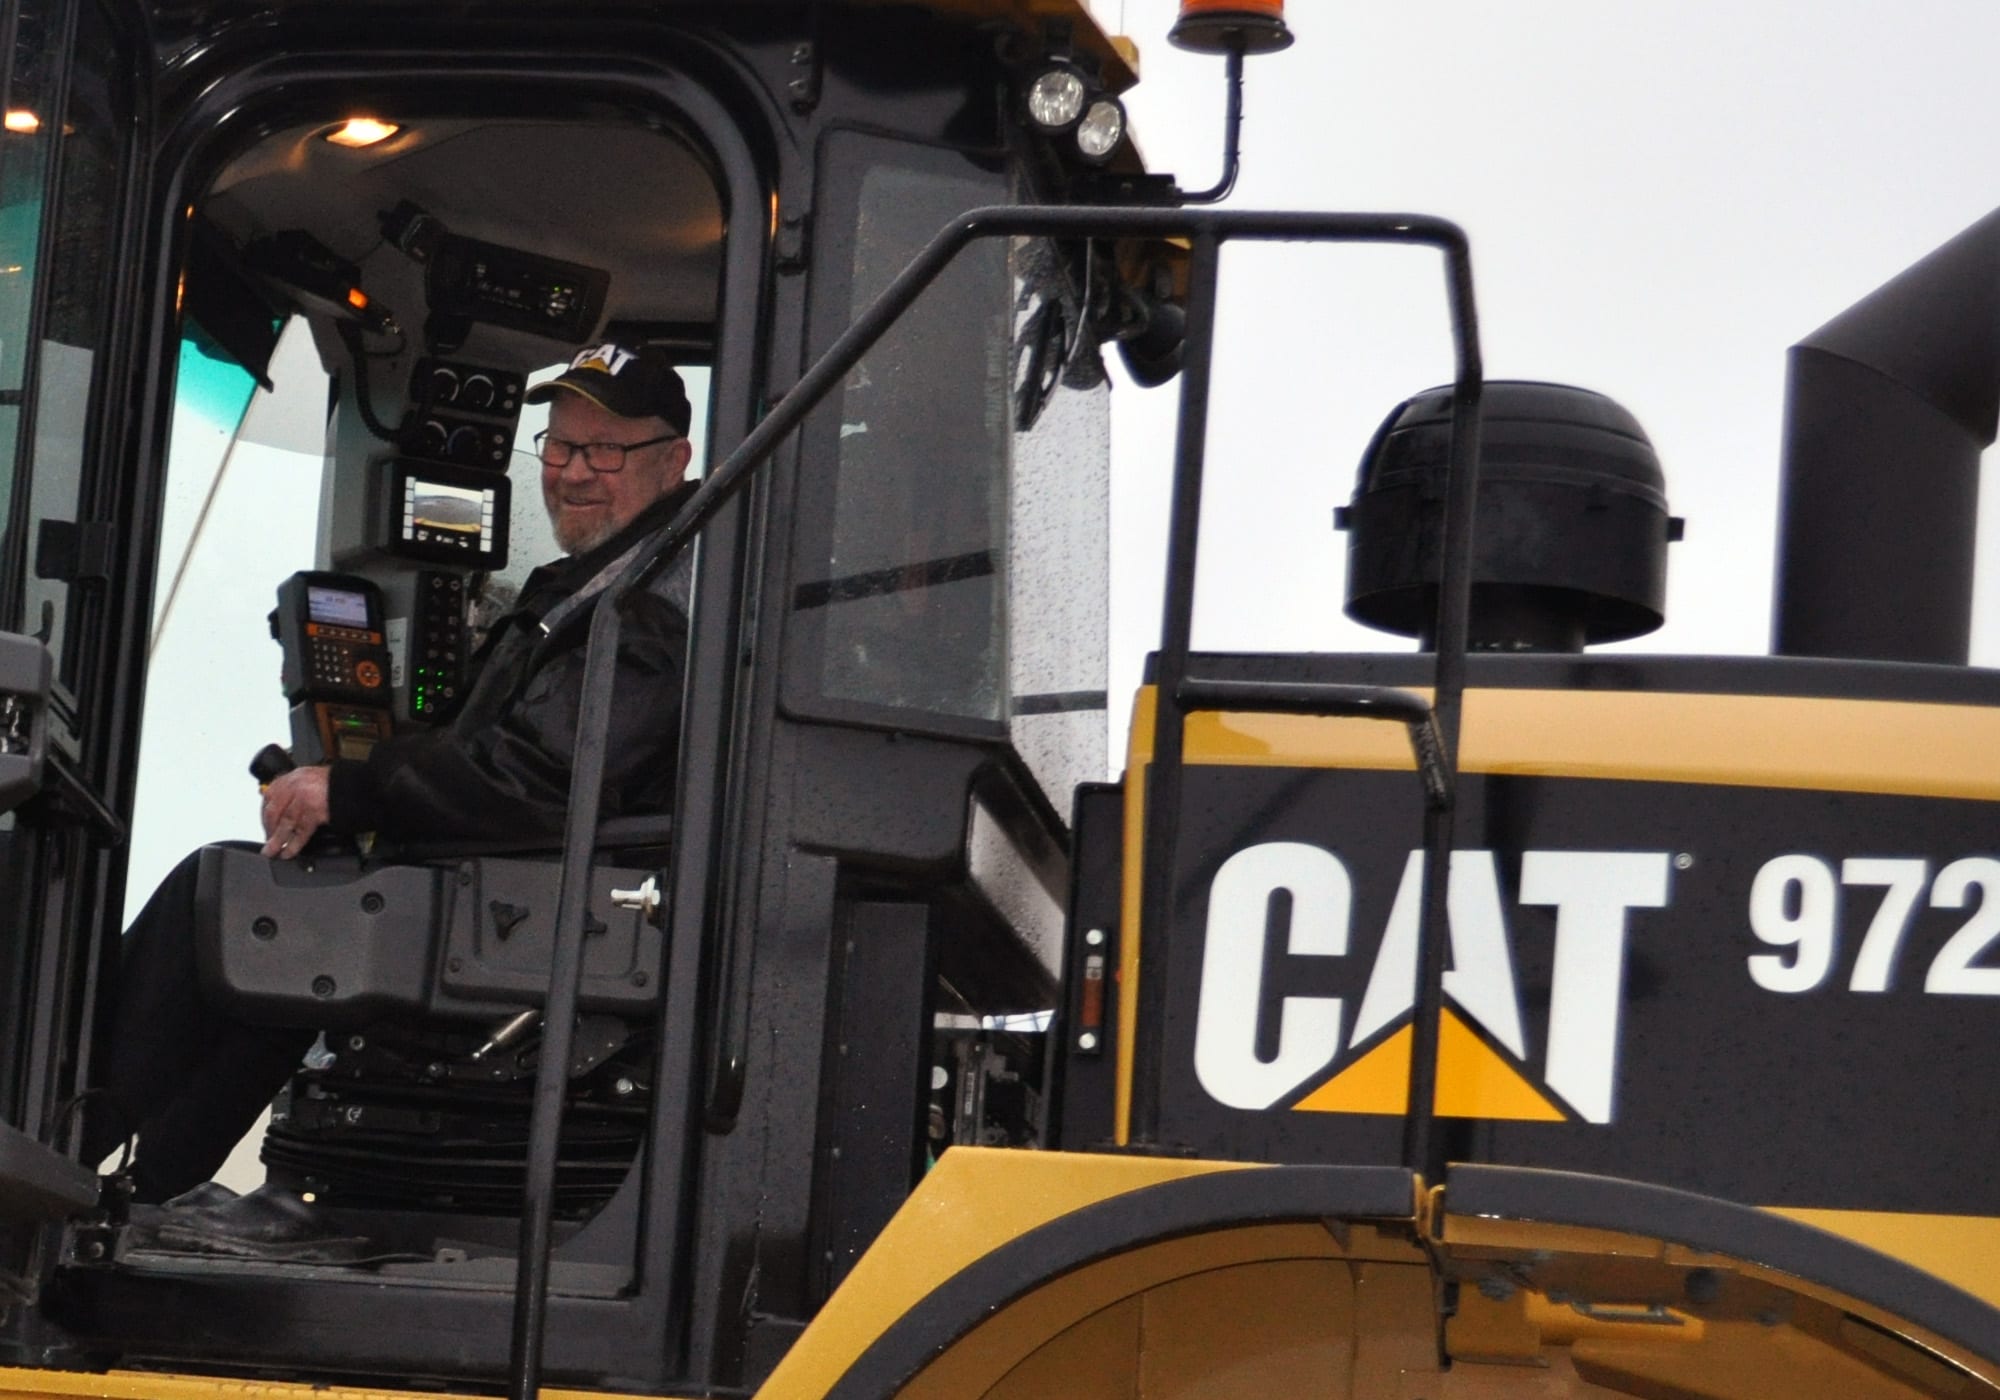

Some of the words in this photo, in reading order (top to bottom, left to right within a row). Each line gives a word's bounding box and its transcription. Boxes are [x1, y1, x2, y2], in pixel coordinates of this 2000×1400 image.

[569, 343, 639, 376] CAT
[1194, 841, 1669, 1124] CAT
[1748, 854, 2000, 996] 972
